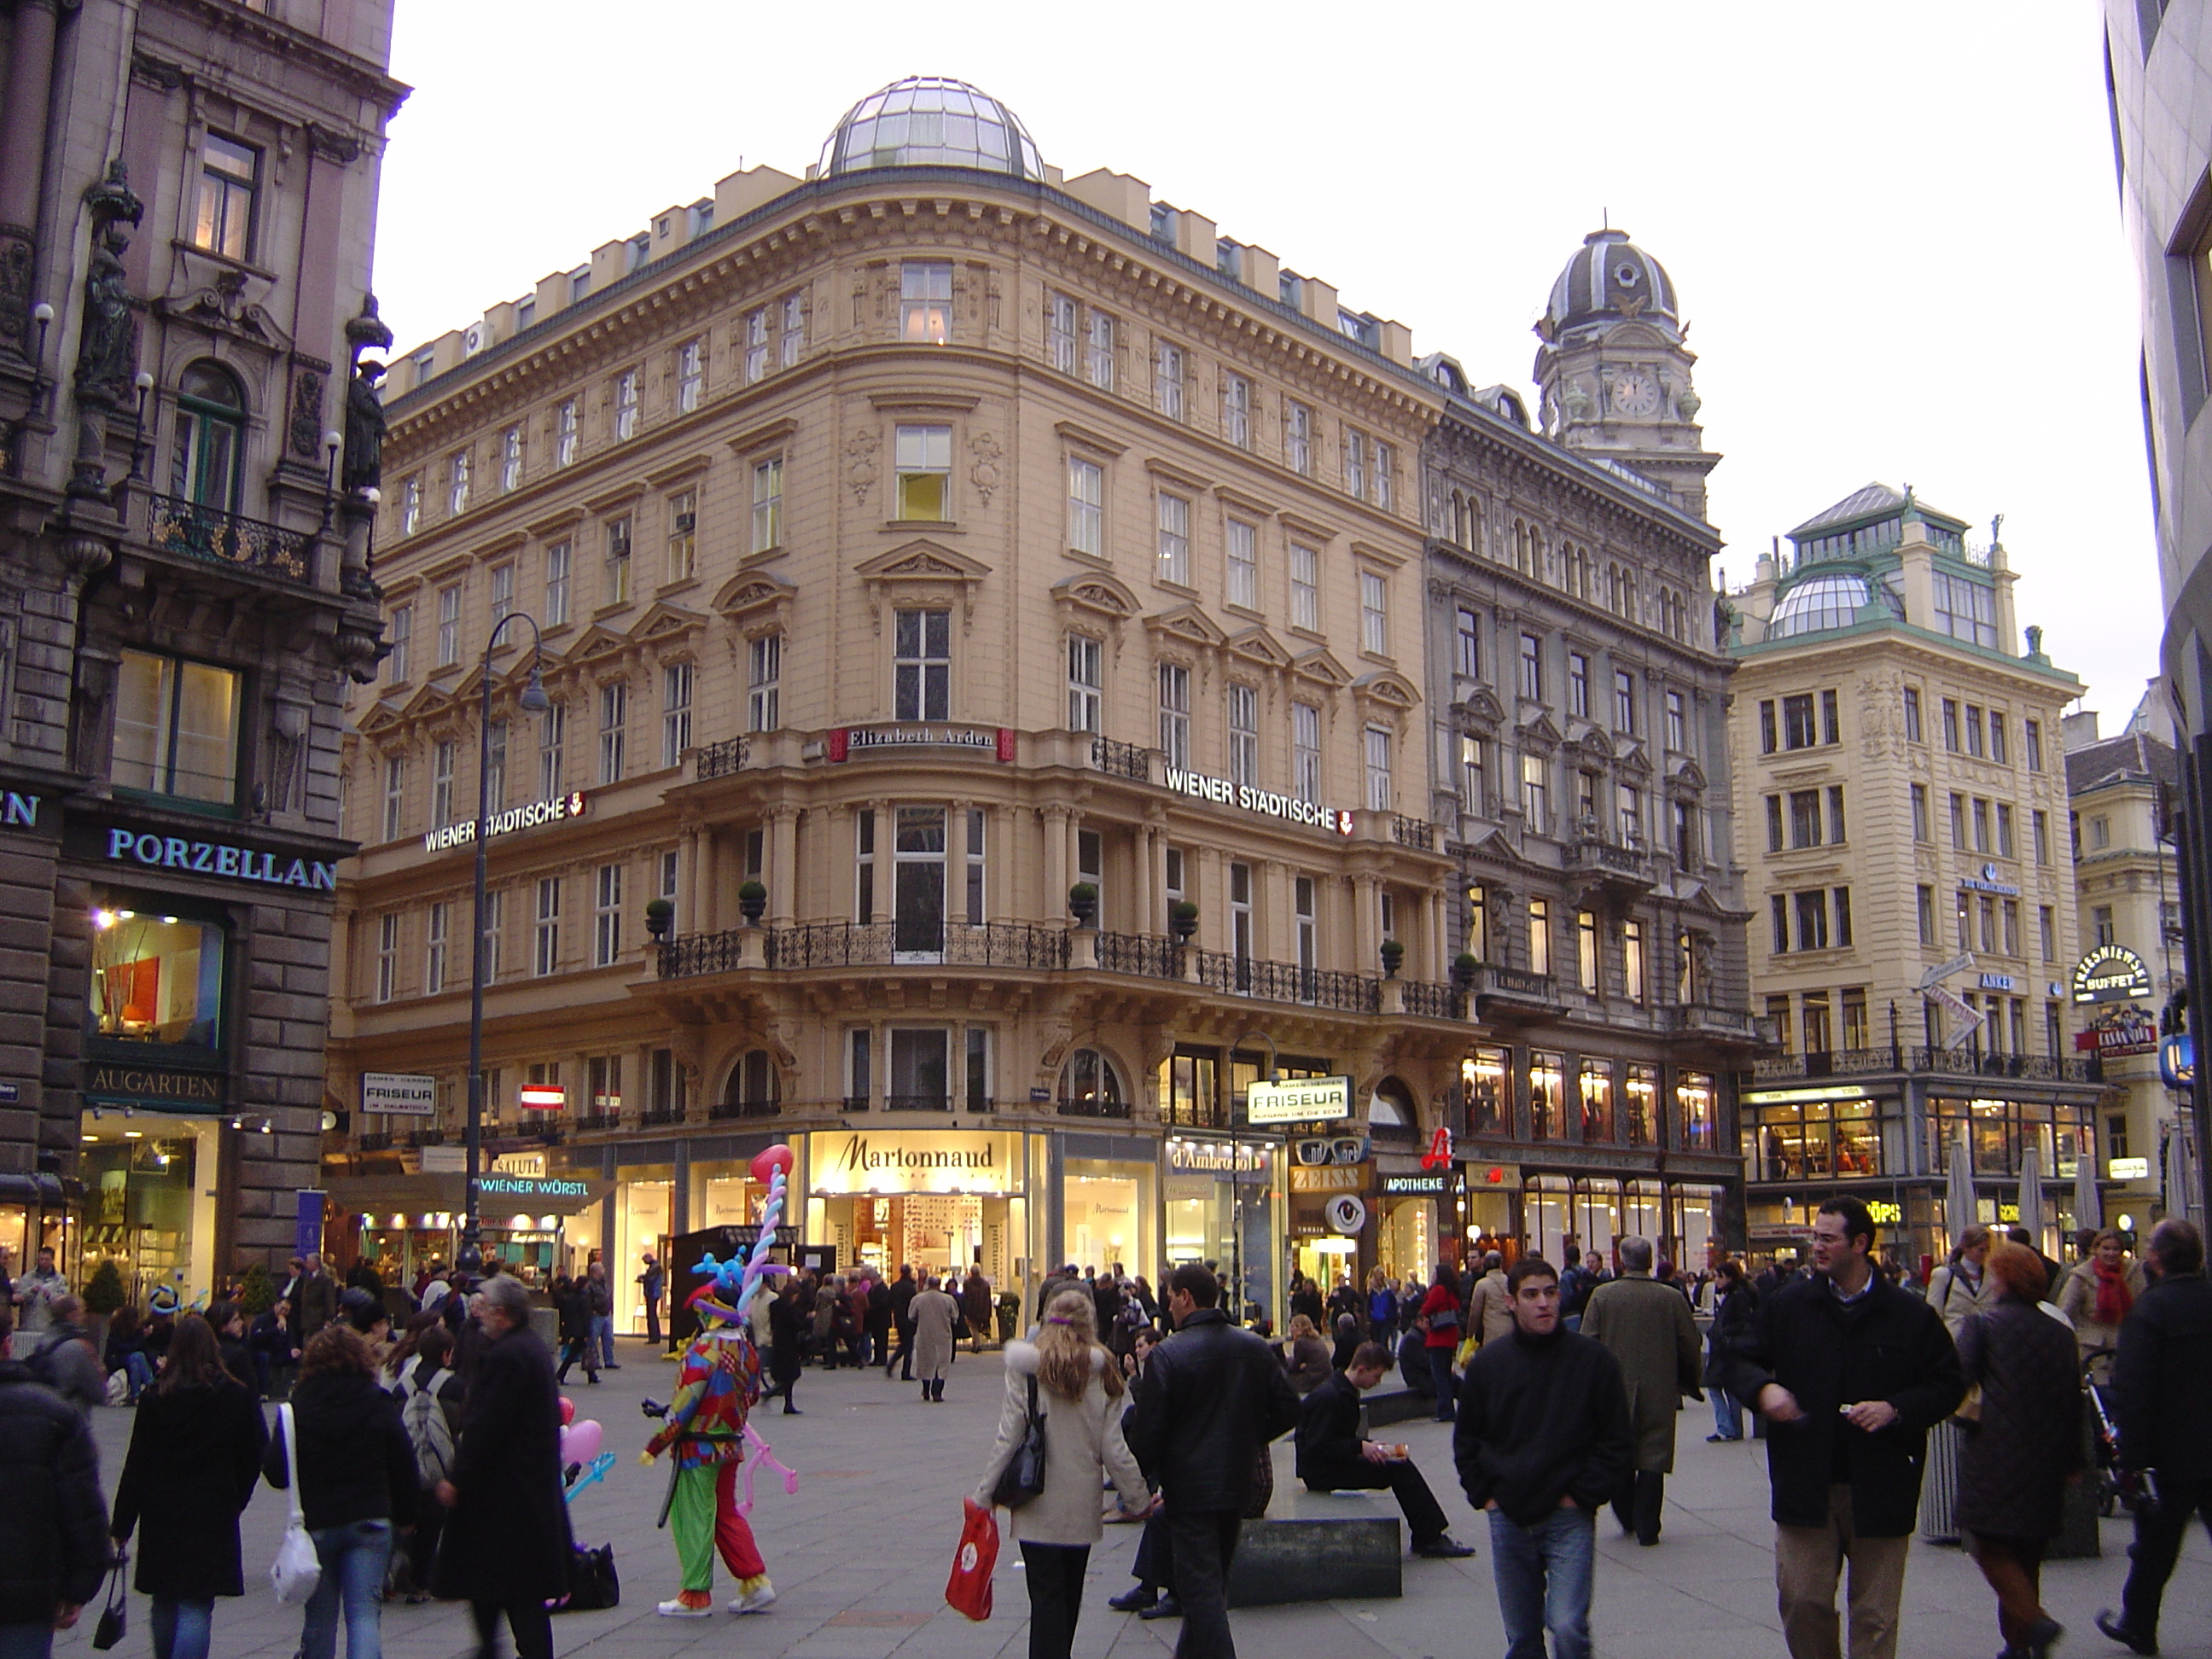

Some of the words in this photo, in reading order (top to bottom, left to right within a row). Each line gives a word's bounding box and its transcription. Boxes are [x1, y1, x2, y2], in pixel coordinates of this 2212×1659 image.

[851, 728, 934, 745] Elizabeth
[944, 729, 992, 746] Arden
[1166, 766, 1233, 805] WIENER
[1239, 785, 1336, 830] STÄDTISCHE
[426, 820, 475, 852] WIENER
[108, 828, 338, 892] PORZELLAN
[1982, 974, 2014, 990] ANKER
[2087, 974, 2134, 990] BUFFET
[92, 1069, 218, 1097] AUGARTEN
[367, 1088, 432, 1101] FRISEUR
[1254, 1091, 1342, 1108] FRISEUR
[836, 1134, 993, 1174] Marionnaud
[498, 1158, 541, 1175] SALUTE
[1294, 1167, 1358, 1189] ZEISS
[1388, 1177, 1443, 1191] APOTHEKE
[480, 1179, 534, 1193] WIENER
[538, 1179, 588, 1195] WÜRSTL
